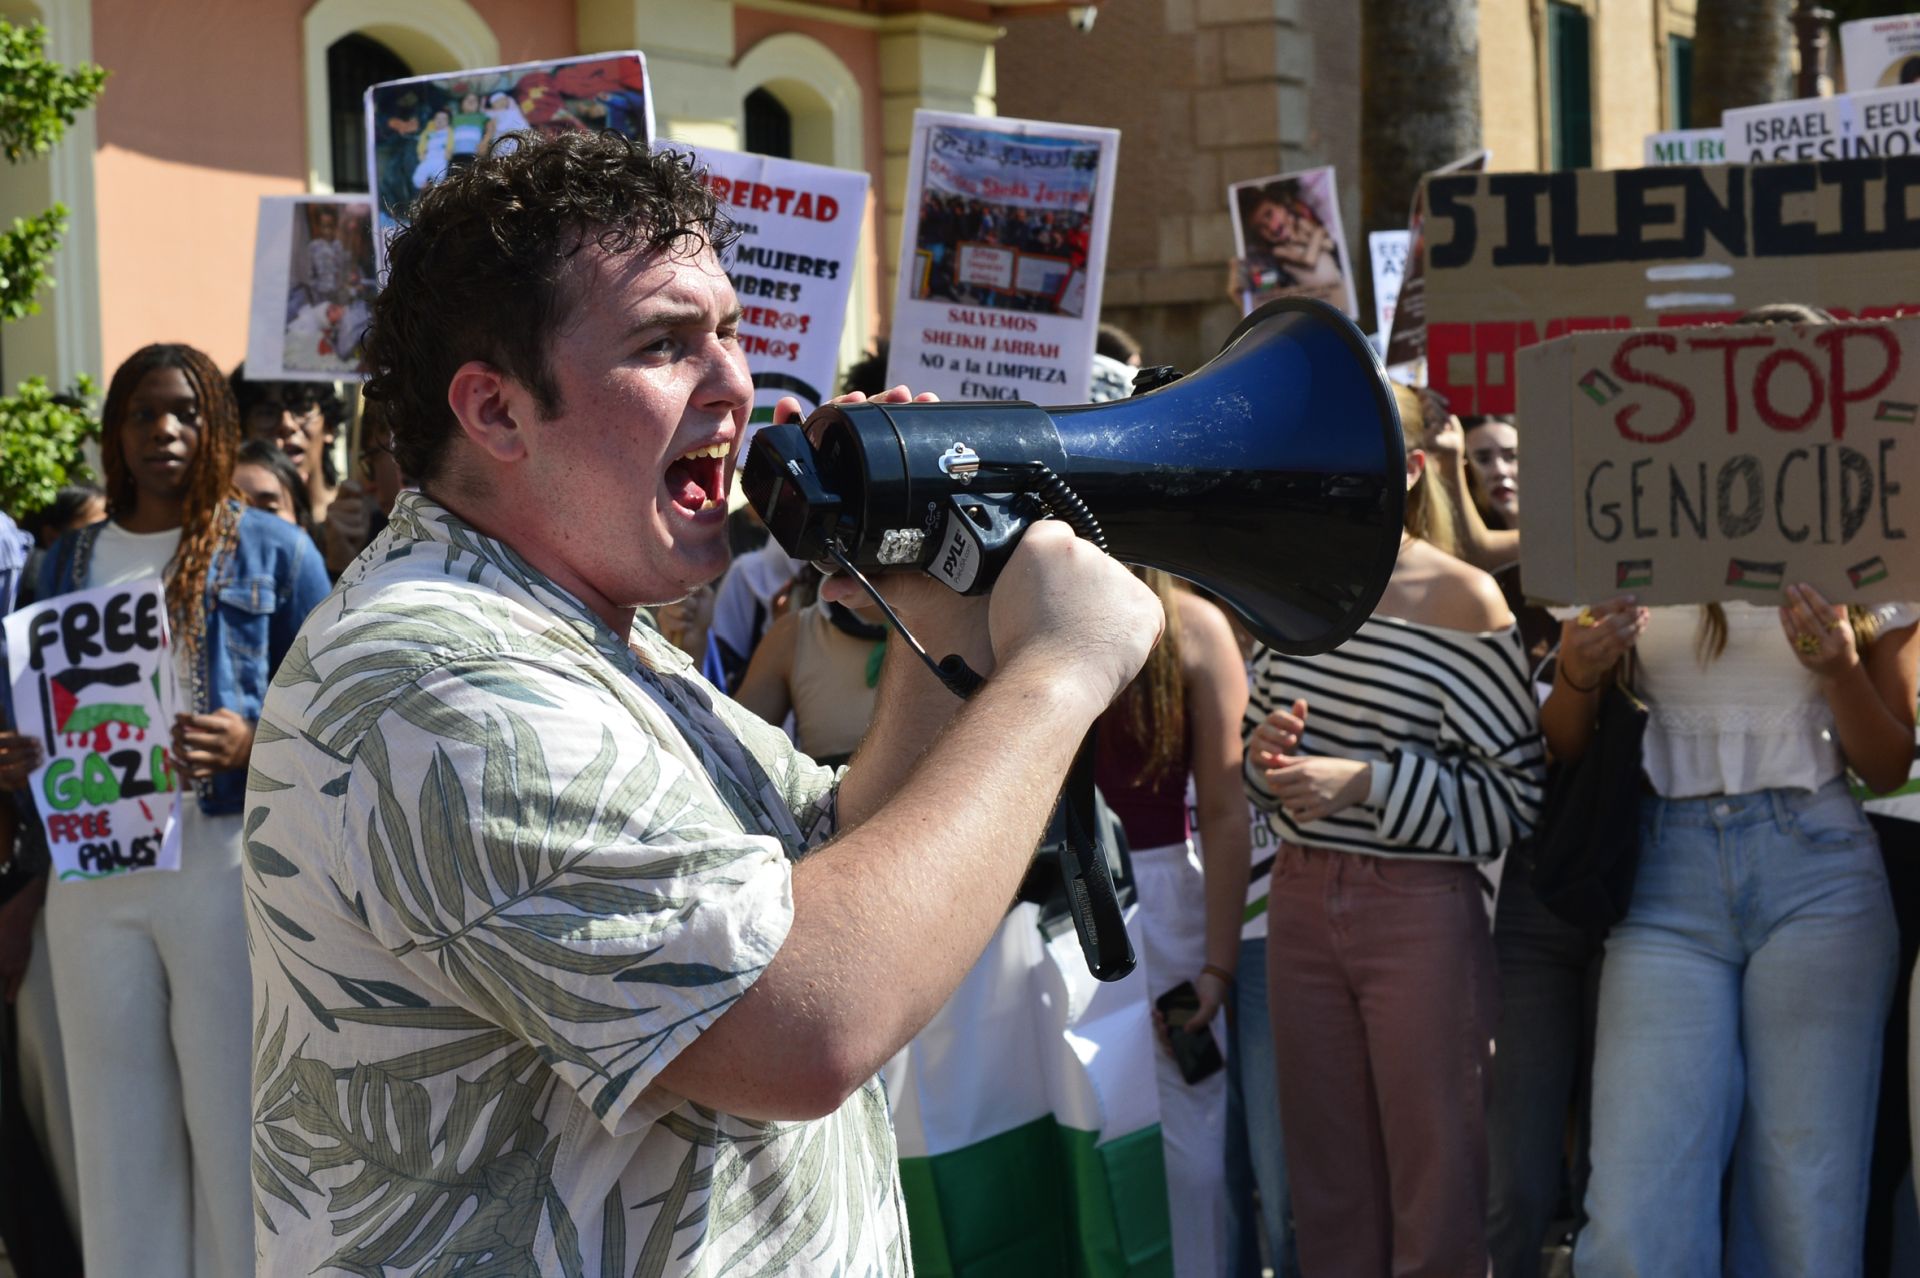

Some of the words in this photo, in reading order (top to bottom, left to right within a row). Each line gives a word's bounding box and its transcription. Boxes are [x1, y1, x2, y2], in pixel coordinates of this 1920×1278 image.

[1745, 112, 1831, 145] ISRAEL
[736, 243, 840, 280] MUJERES
[727, 272, 802, 303] MBRES
[947, 308, 1038, 332] SALVEMOS
[922, 328, 987, 351] SHEIKH
[991, 338, 1061, 360] JARRAH
[920, 352, 945, 369] NO
[949, 359, 960, 374] a
[965, 357, 981, 375] la
[986, 360, 1068, 385] LIMPIEZA
[1610, 325, 1902, 444] STOP
[960, 378, 1021, 401] ÉTNICA
[1585, 438, 1906, 545] GENOCIDE
[942, 531, 967, 578] PYLE
[29, 592, 160, 672] FREE
[48, 809, 112, 844] FREE
